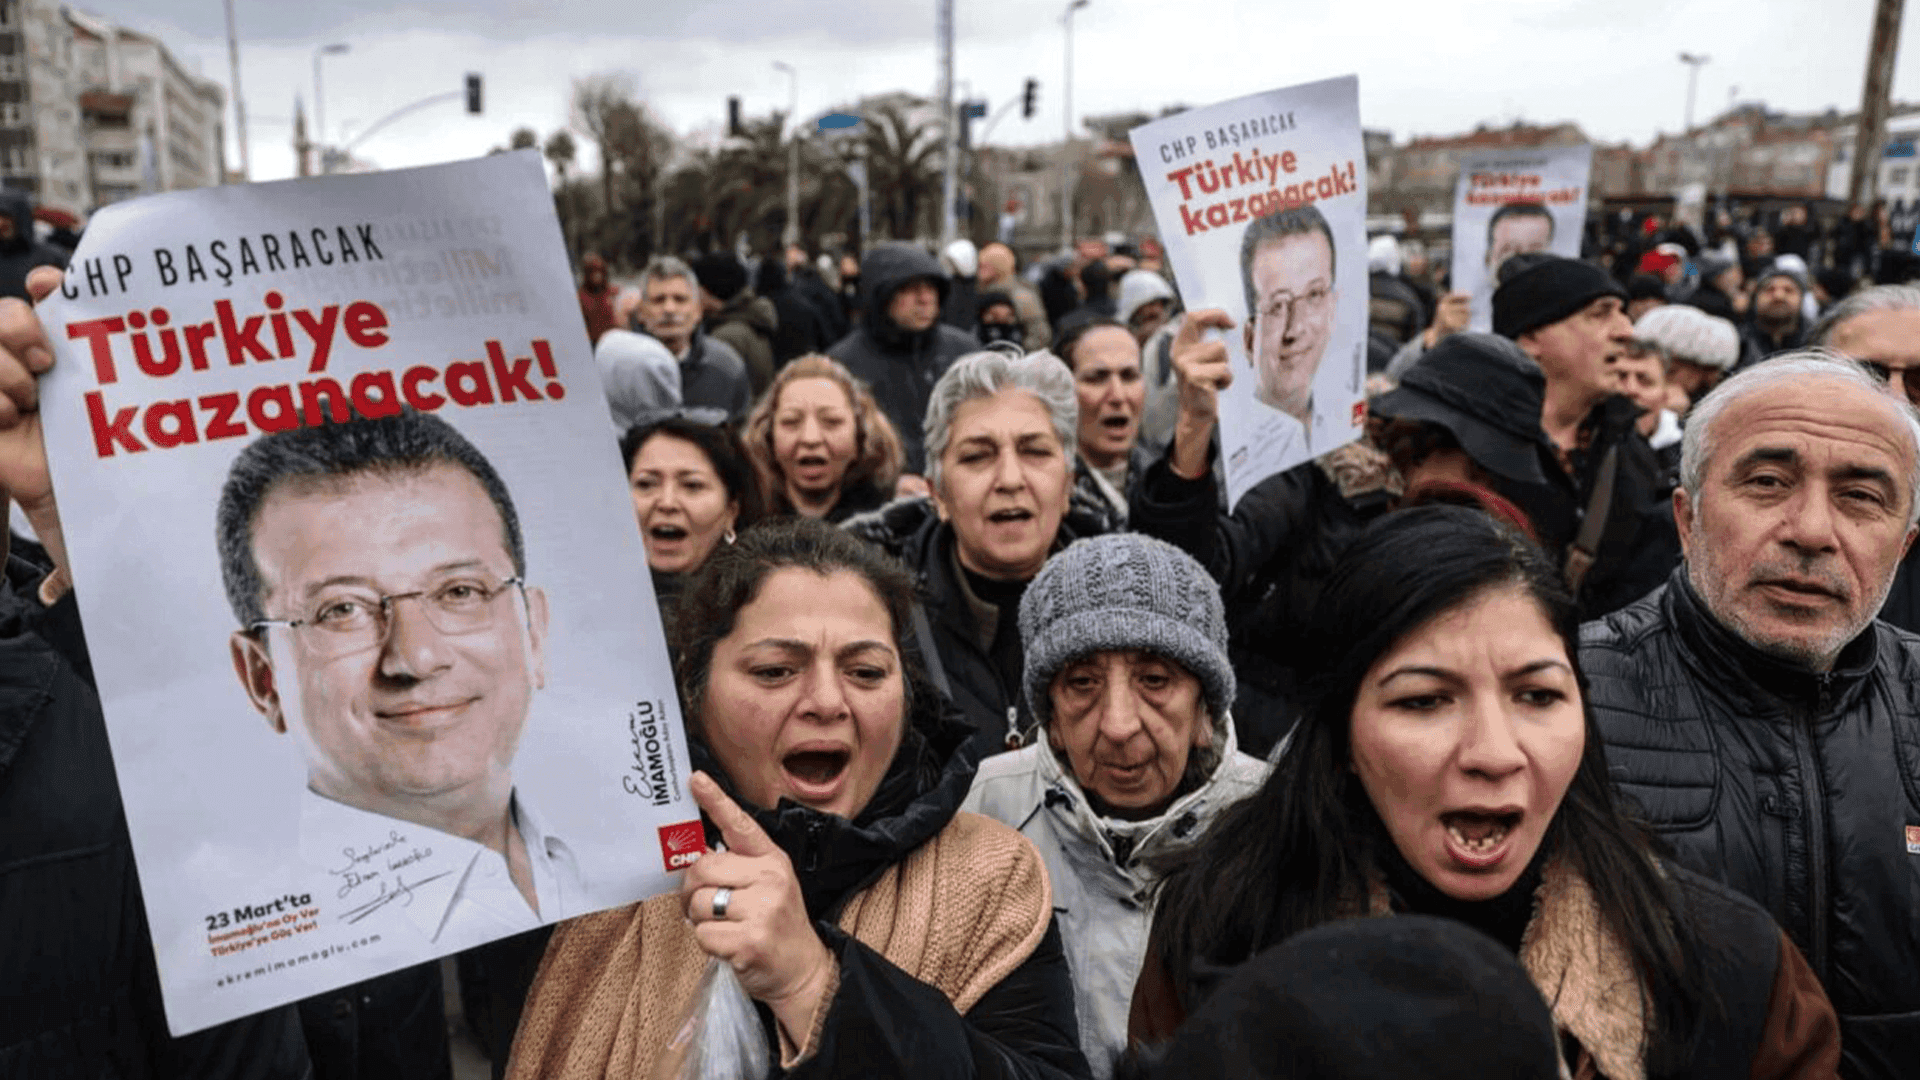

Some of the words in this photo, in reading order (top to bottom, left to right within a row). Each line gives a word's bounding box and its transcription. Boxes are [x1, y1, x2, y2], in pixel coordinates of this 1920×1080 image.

[1159, 136, 1198, 164] CHP
[1204, 110, 1298, 148] BAŞARACAK
[1166, 148, 1298, 201] Türkiye
[1178, 161, 1357, 236] kazanacak!
[61, 253, 133, 300] CHP
[155, 222, 385, 287] BAŞARACAK
[65, 290, 391, 385] Türkiye
[83, 339, 567, 458] kazanacak!
[637, 700, 671, 807] İMAMOĞLU
[669, 851, 702, 868] CHP
[205, 912, 231, 931] 23
[233, 893, 312, 923] Mart'ta
